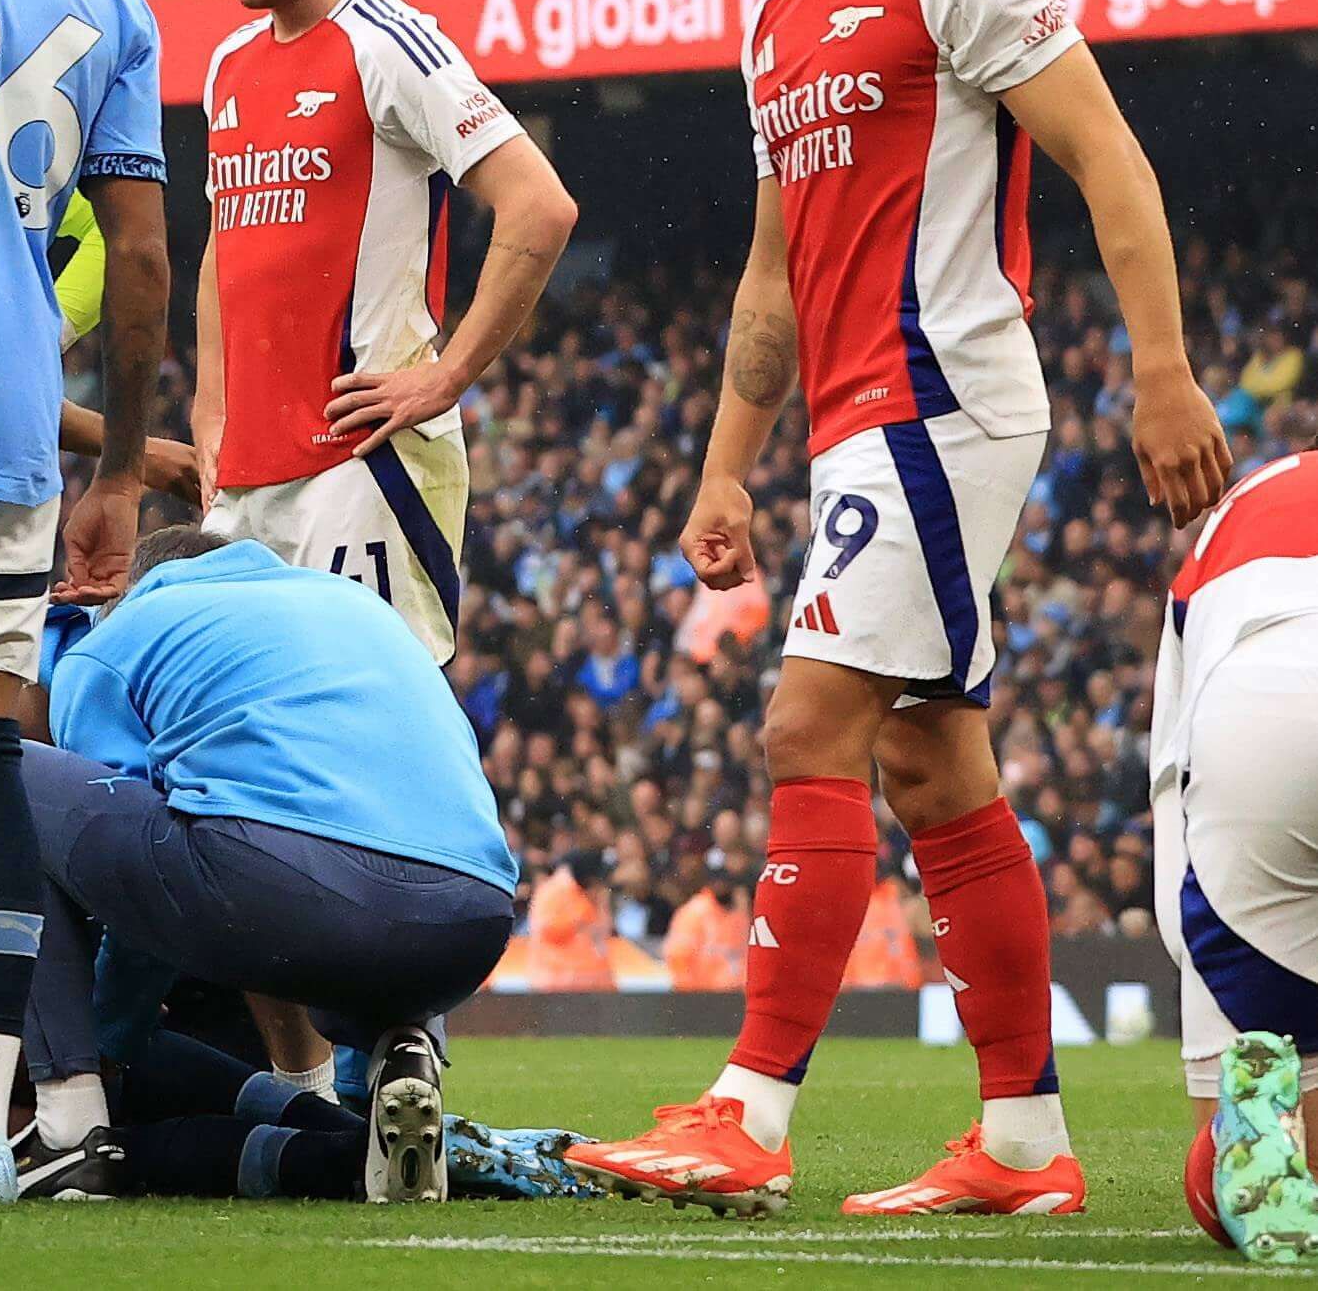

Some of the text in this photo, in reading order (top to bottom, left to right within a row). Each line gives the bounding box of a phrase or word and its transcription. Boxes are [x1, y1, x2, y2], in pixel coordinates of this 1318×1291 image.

[208, 141, 332, 190] Emirates
[791, 124, 853, 182] BETTER
[218, 188, 306, 232] FLY BETTER
[932, 917, 950, 937] C
